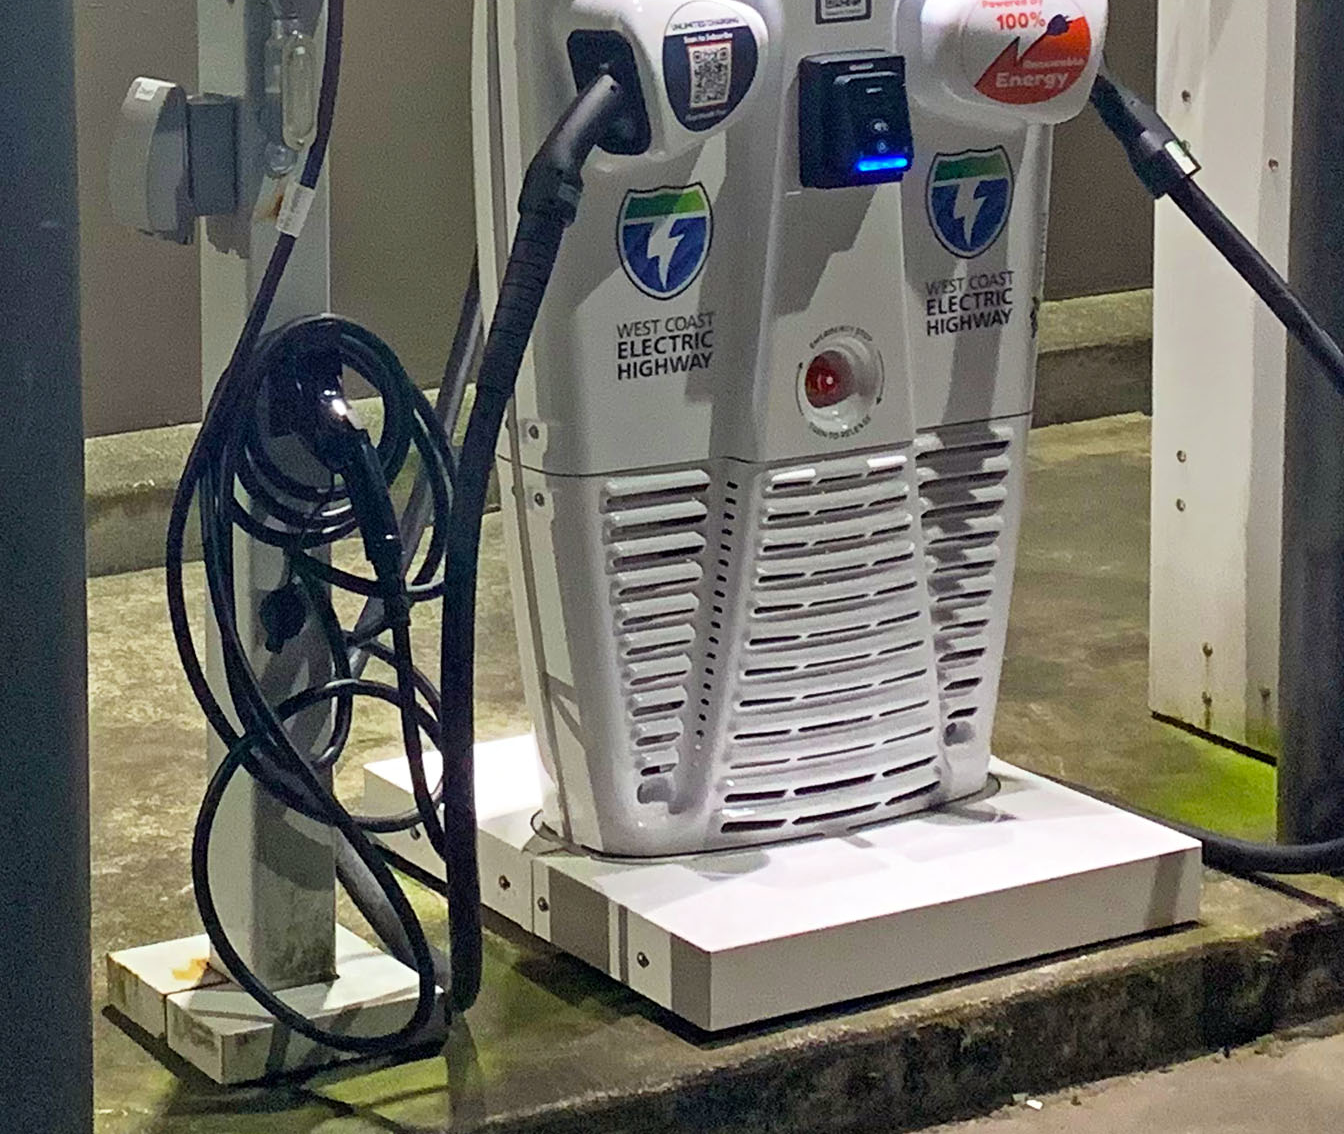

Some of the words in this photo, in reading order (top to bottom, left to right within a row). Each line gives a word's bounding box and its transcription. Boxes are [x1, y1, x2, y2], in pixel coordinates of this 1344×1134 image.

[996, 11, 1046, 30] 100%
[996, 71, 1069, 89] Energy
[925, 277, 966, 296] WEST
[968, 270, 1015, 290] COAST
[926, 287, 1014, 317] ELECTRIC
[616, 318, 661, 339] WEST
[665, 311, 715, 333] COAST
[926, 308, 1014, 337] HIGHWAY
[617, 329, 714, 360] ELECTRIC
[617, 351, 714, 381] HIGHWAY
